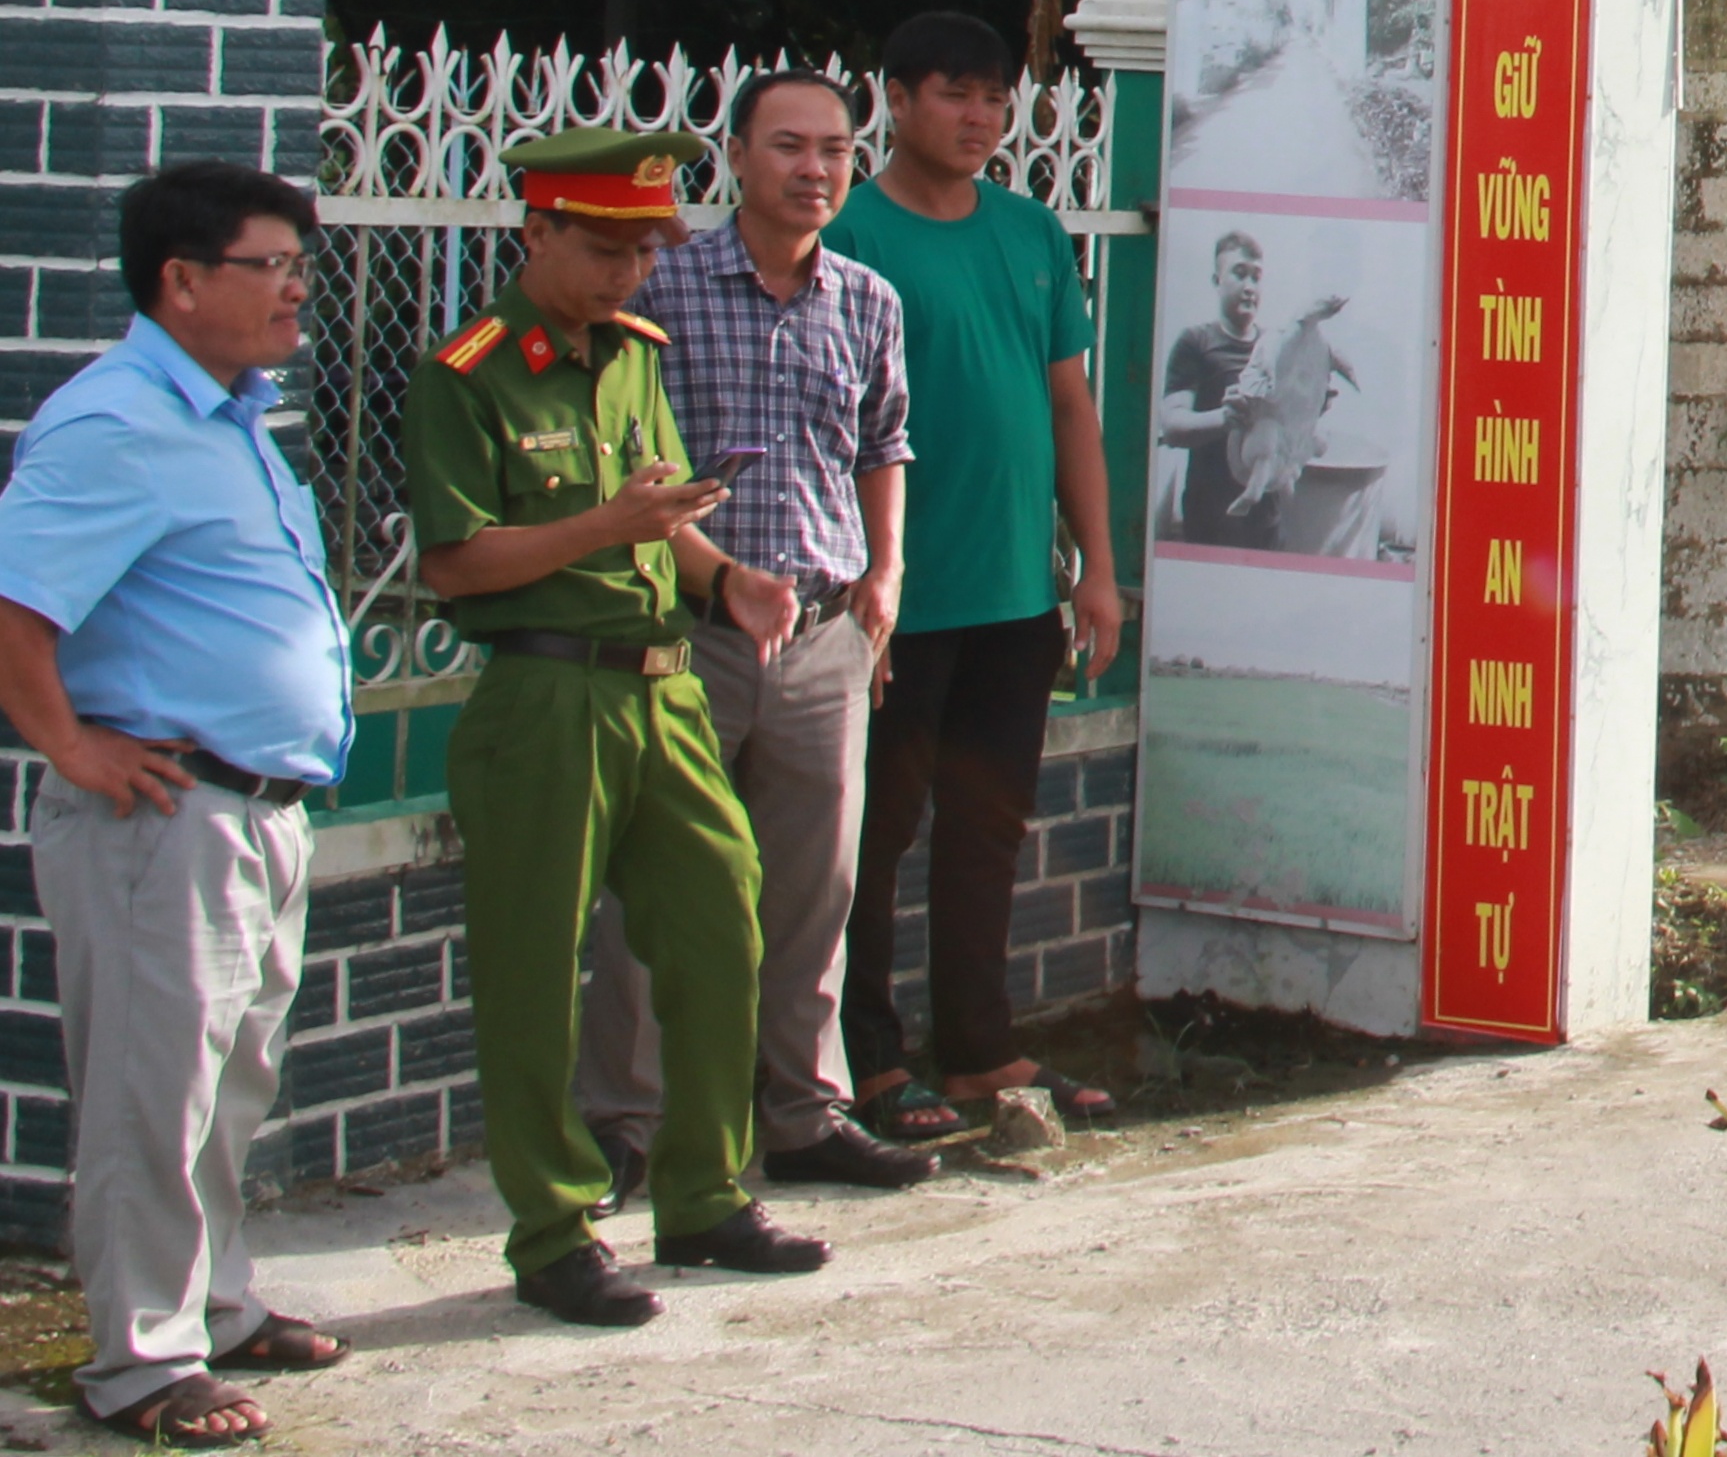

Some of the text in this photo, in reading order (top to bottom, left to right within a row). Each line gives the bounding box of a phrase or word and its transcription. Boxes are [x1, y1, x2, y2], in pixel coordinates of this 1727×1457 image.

[1477, 156, 1551, 242] VỮNG
[1479, 278, 1543, 363] TÌNH
[1474, 401, 1540, 485] HÌNH
[1483, 538, 1522, 606] AN
[1469, 660, 1533, 729] NINH
[1462, 765, 1535, 862] TRẬT
[1475, 892, 1517, 984] TỰ
